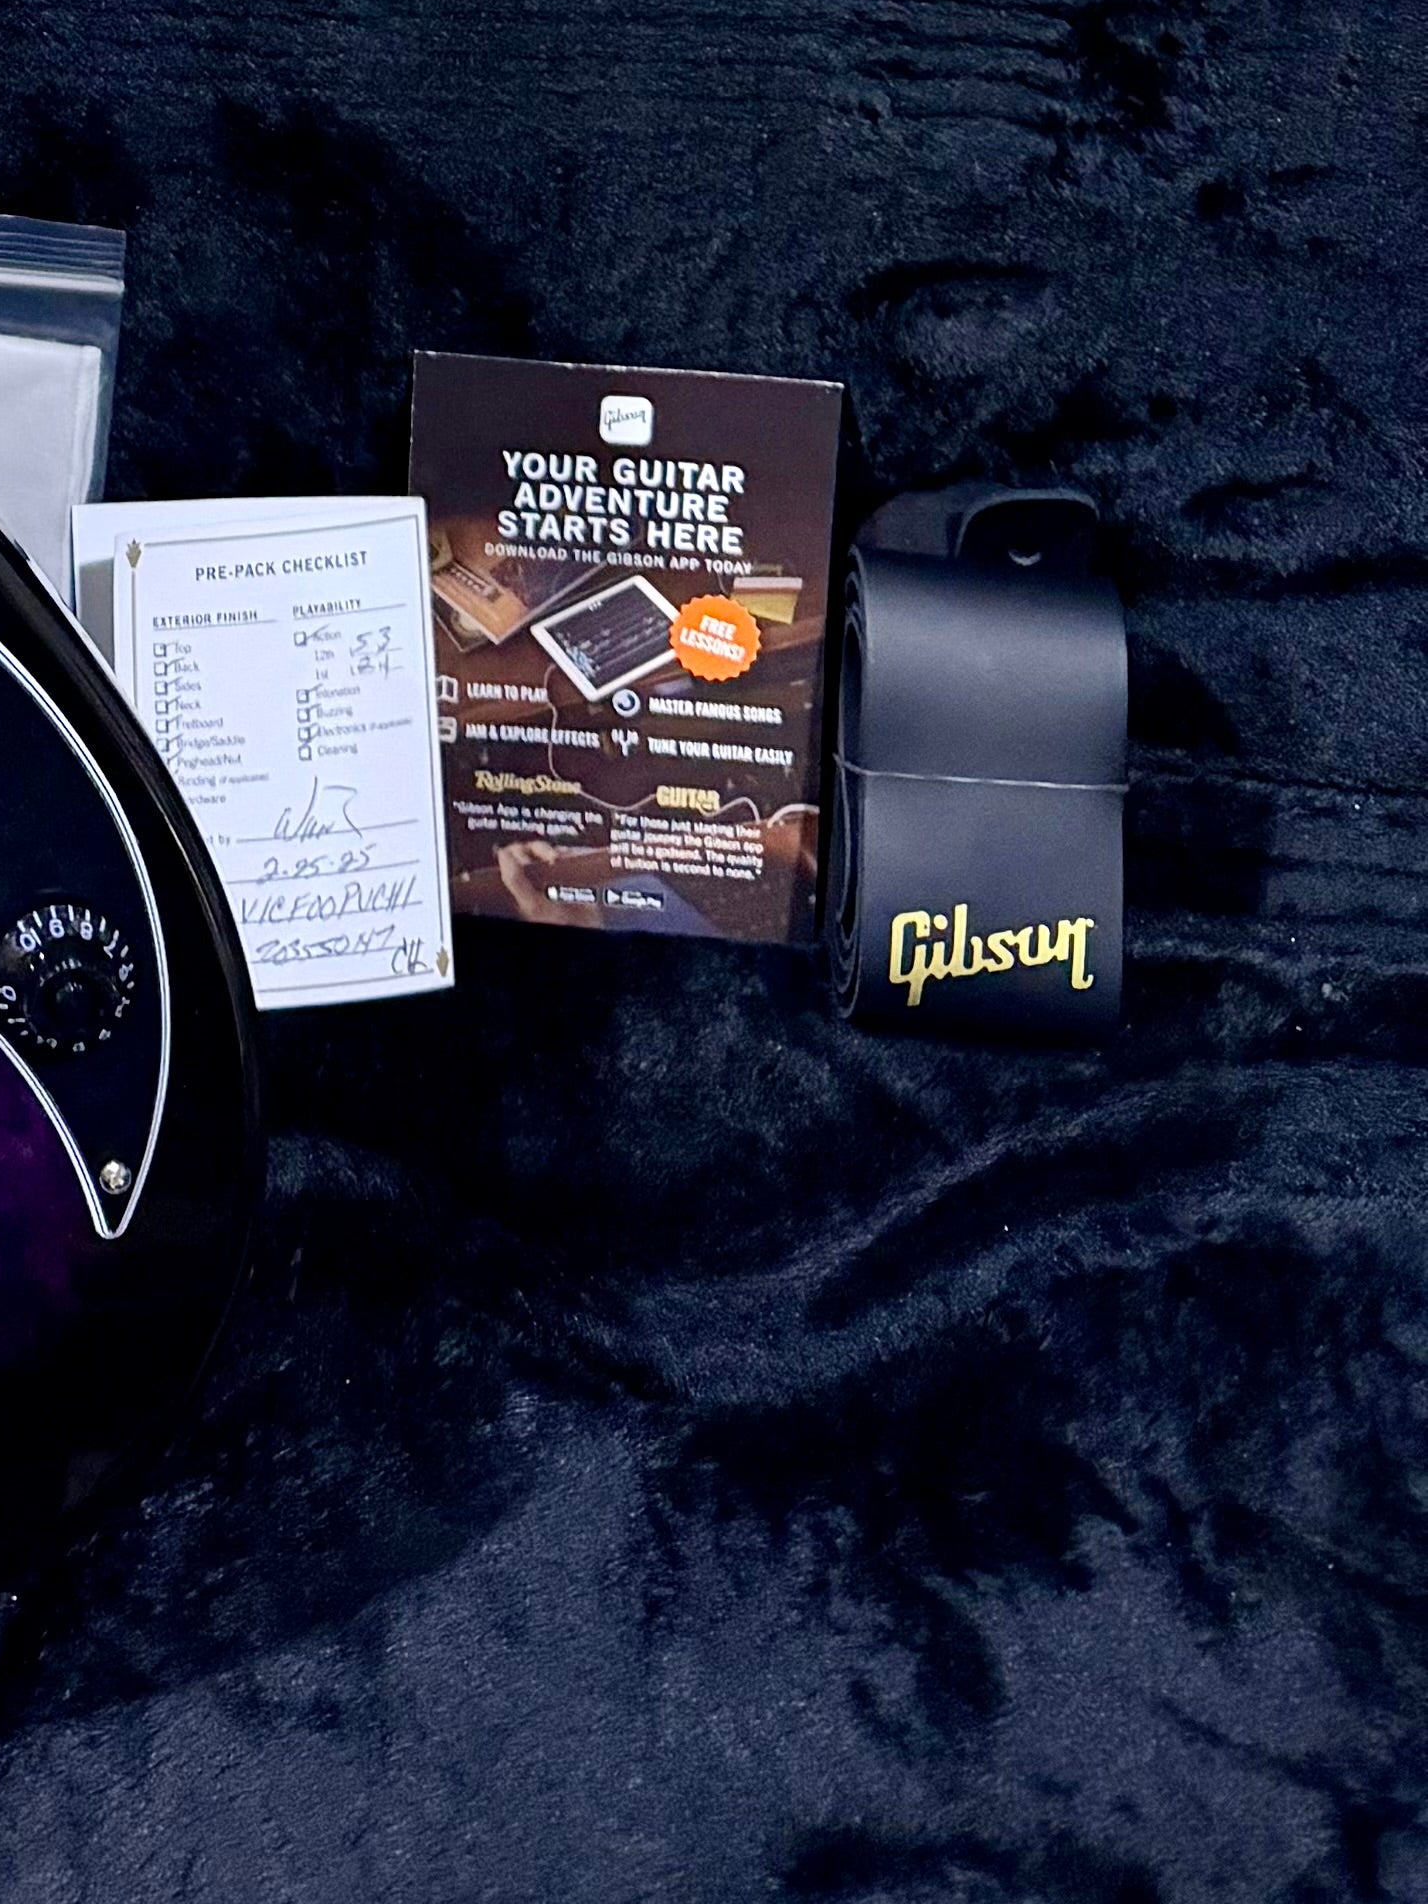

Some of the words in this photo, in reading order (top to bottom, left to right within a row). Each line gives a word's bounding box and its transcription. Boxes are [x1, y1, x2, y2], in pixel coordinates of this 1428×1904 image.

[502, 450, 597, 483] YOUR
[613, 458, 745, 494] GUITAR
[514, 482, 729, 524] ADVENTURE
[497, 510, 630, 547] STARTS
[647, 519, 743, 556] HERE
[195, 560, 276, 581] PRE-PACK
[282, 551, 368, 575] CHECKLIST
[484, 542, 568, 562] DOWNLOAD
[573, 548, 601, 564] THE
[606, 552, 664, 569] GIBSON
[669, 556, 700, 571] APP
[705, 558, 753, 575] TODAY
[153, 613, 212, 628] EXTERIOR
[216, 610, 258, 623] FINISH
[292, 598, 361, 616] PLAYABILITY
[700, 614, 737, 641] FREE
[466, 683, 502, 700] LEARN
[504, 685, 518, 701] TO
[520, 686, 549, 703] PLAY
[649, 697, 694, 716] MASTER
[695, 700, 742, 720] FAMOUS
[743, 705, 782, 724] SONGS
[465, 723, 487, 739] JAM
[500, 725, 549, 744] EXPLORE
[550, 728, 600, 749] EFFECTS
[647, 736, 676, 754] TUNE
[679, 739, 710, 758] YOUR
[711, 744, 752, 763] GUITAR
[754, 747, 794, 766] EASILY
[888, 903, 1095, 1006] Gibson
